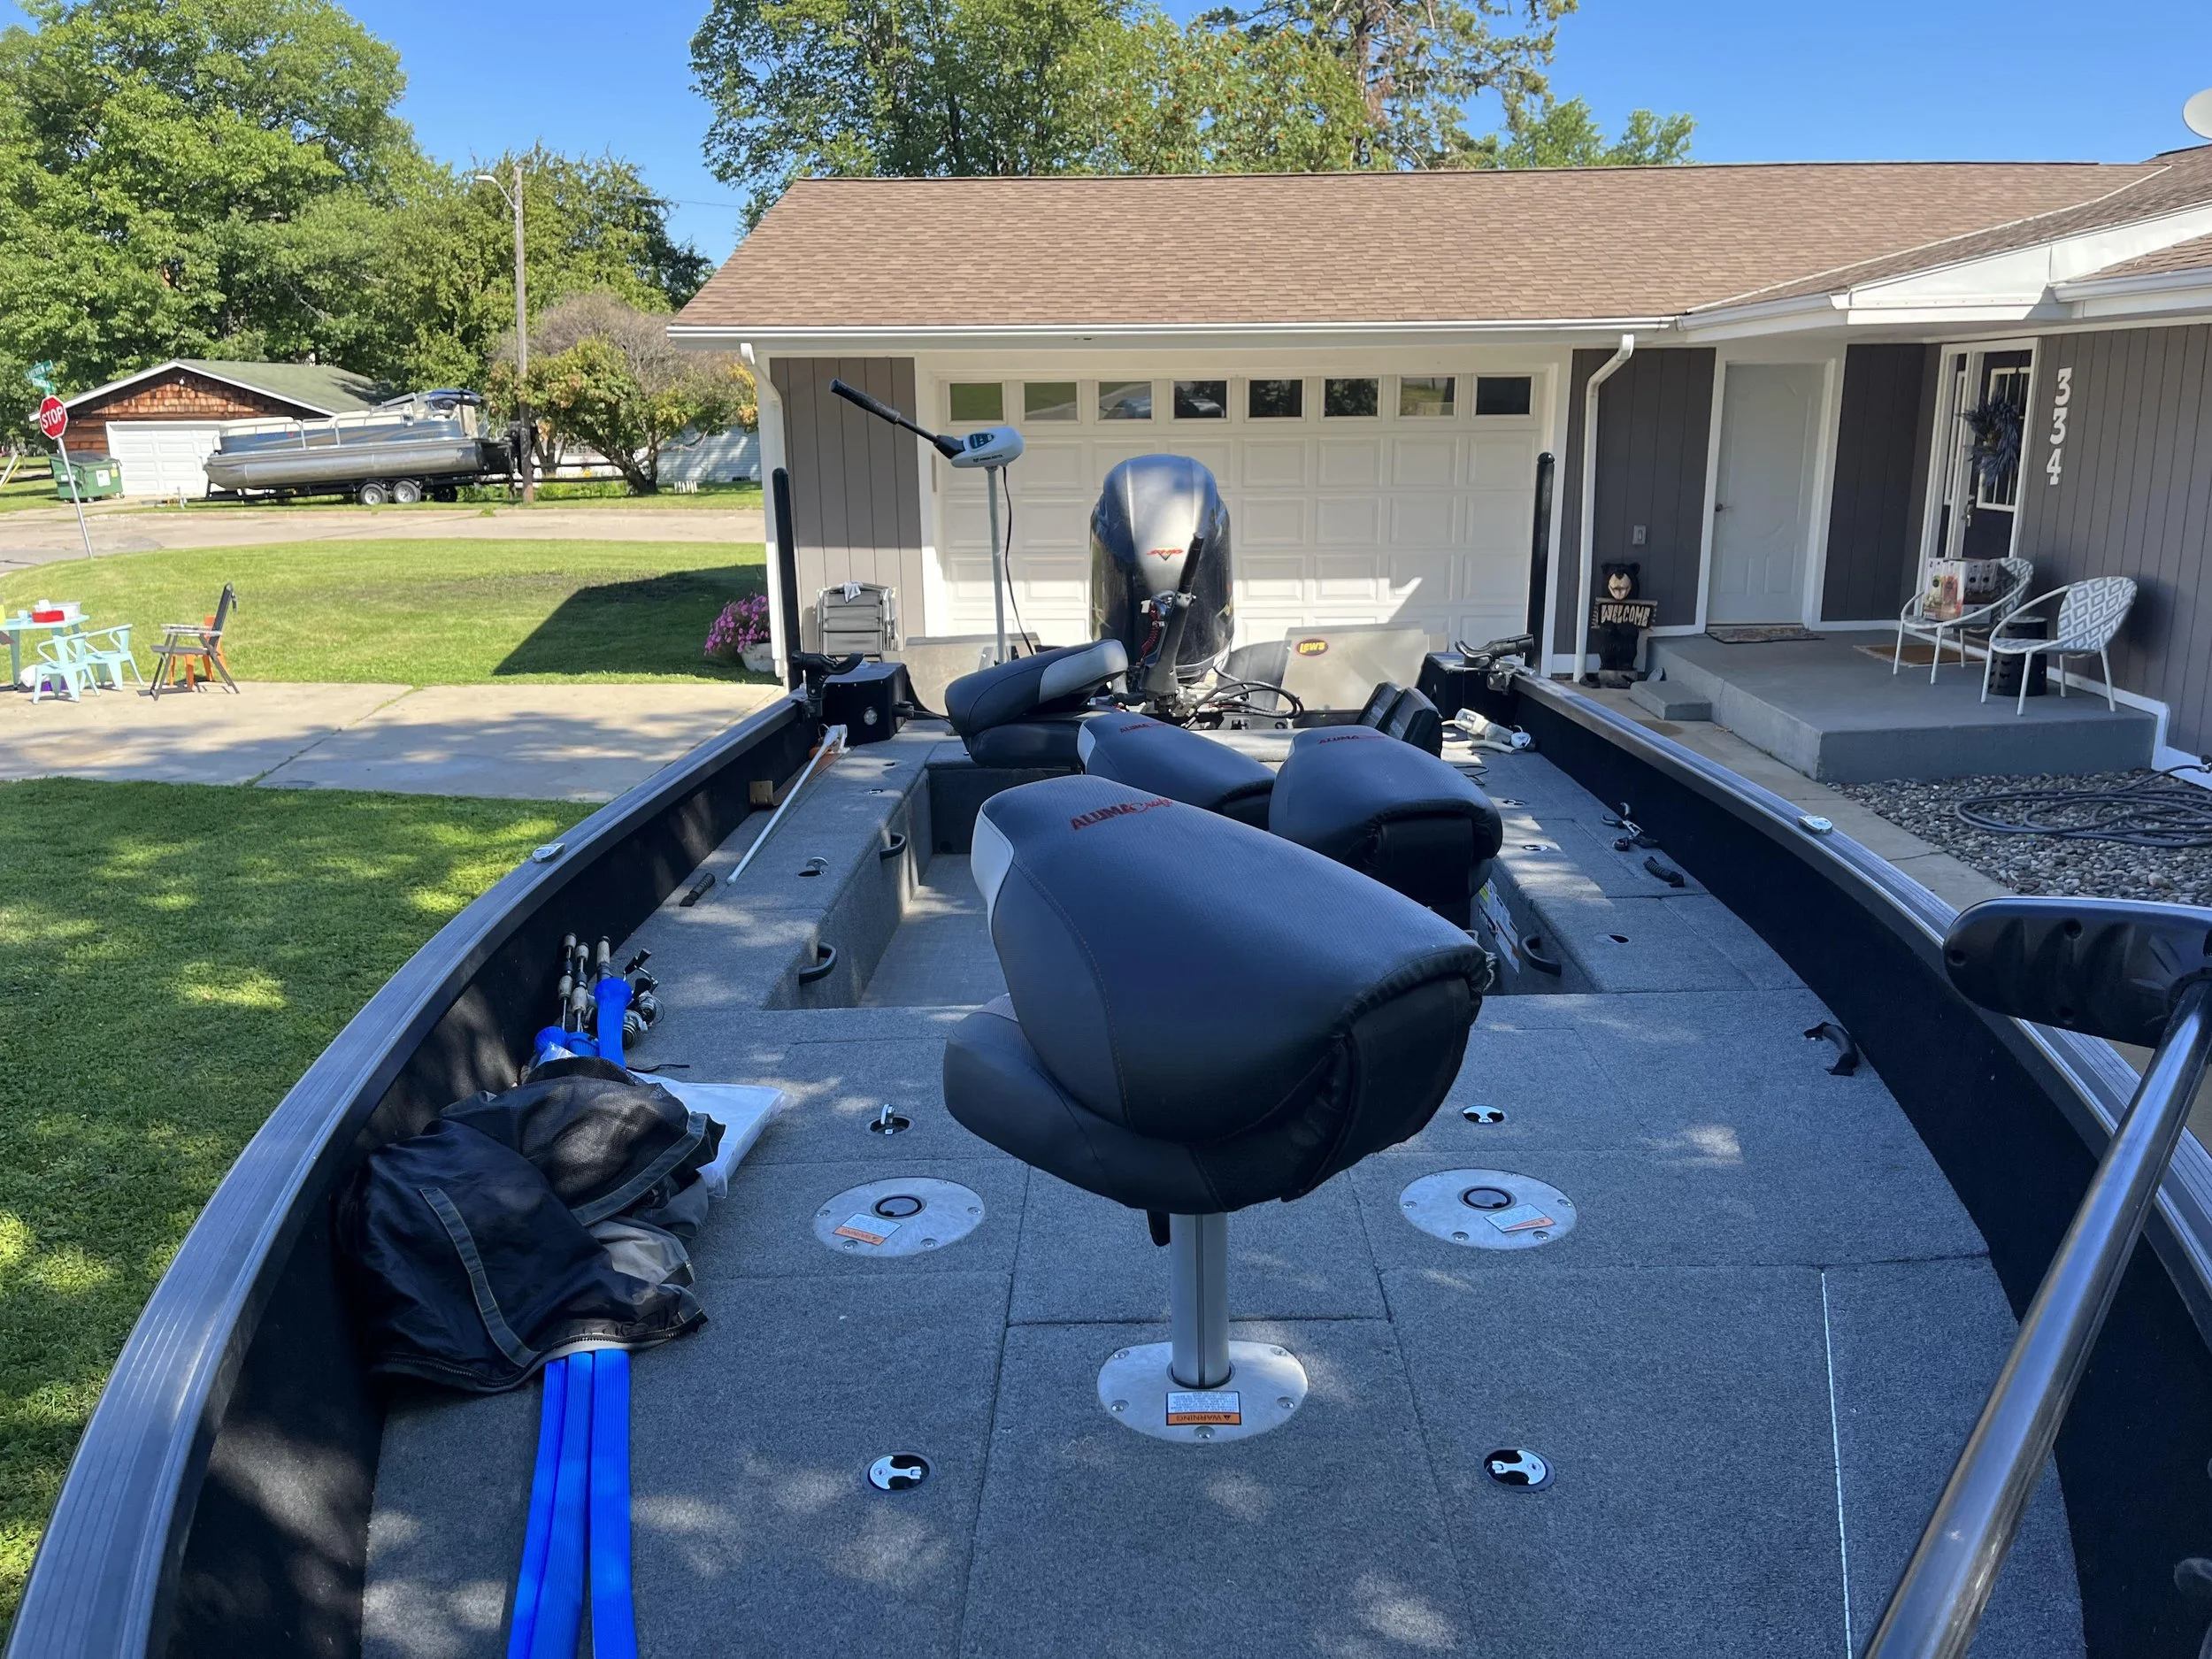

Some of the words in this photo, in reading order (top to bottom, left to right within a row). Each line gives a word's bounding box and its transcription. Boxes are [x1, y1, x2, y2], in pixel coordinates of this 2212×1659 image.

[42, 406, 64, 429] STOP
[2047, 367, 2072, 486] 334
[1601, 604, 1651, 627] WELCOME
